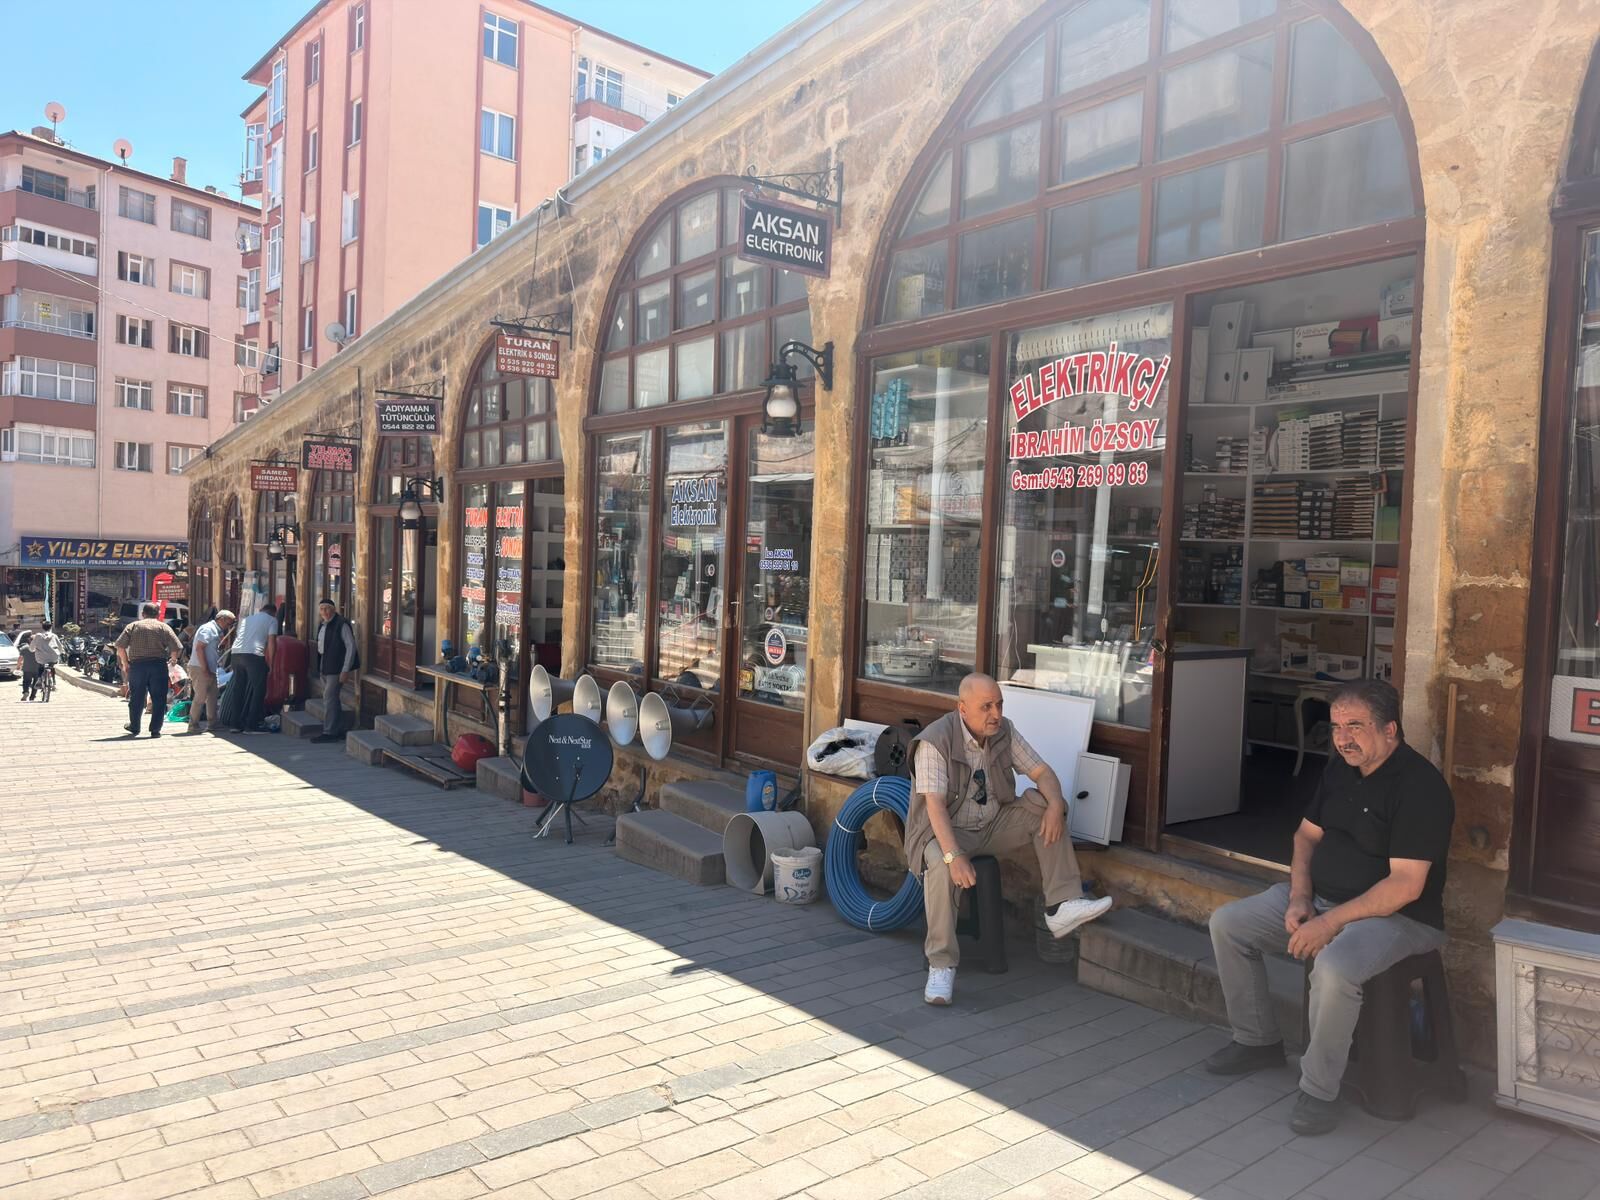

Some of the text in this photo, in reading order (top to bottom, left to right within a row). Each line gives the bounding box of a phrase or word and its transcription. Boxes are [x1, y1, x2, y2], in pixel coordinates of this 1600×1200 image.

[752, 211, 819, 245] AKSAN
[746, 234, 824, 264] ELEKTRONİK
[505, 337, 551, 350] TURAN
[499, 347, 528, 358] ELEKTRİK
[534, 352, 556, 361] SONDAJ
[1009, 341, 1171, 423] ELEKTRİKÇİ
[381, 413, 436, 422] TÜTÜNCÜLÜK
[385, 405, 430, 413] ADIYAMAN
[1009, 418, 1160, 460] İBRAHİM ÖZSOY
[310, 445, 352, 456] YILMAZ
[1011, 462, 1148, 491] Gsm:0543 269 89 83
[671, 478, 718, 504] AKSAN
[671, 503, 717, 526] Elektronik
[47, 541, 177, 559] YILDIZ ELEKTR
[774, 548, 794, 560] AKSAN
